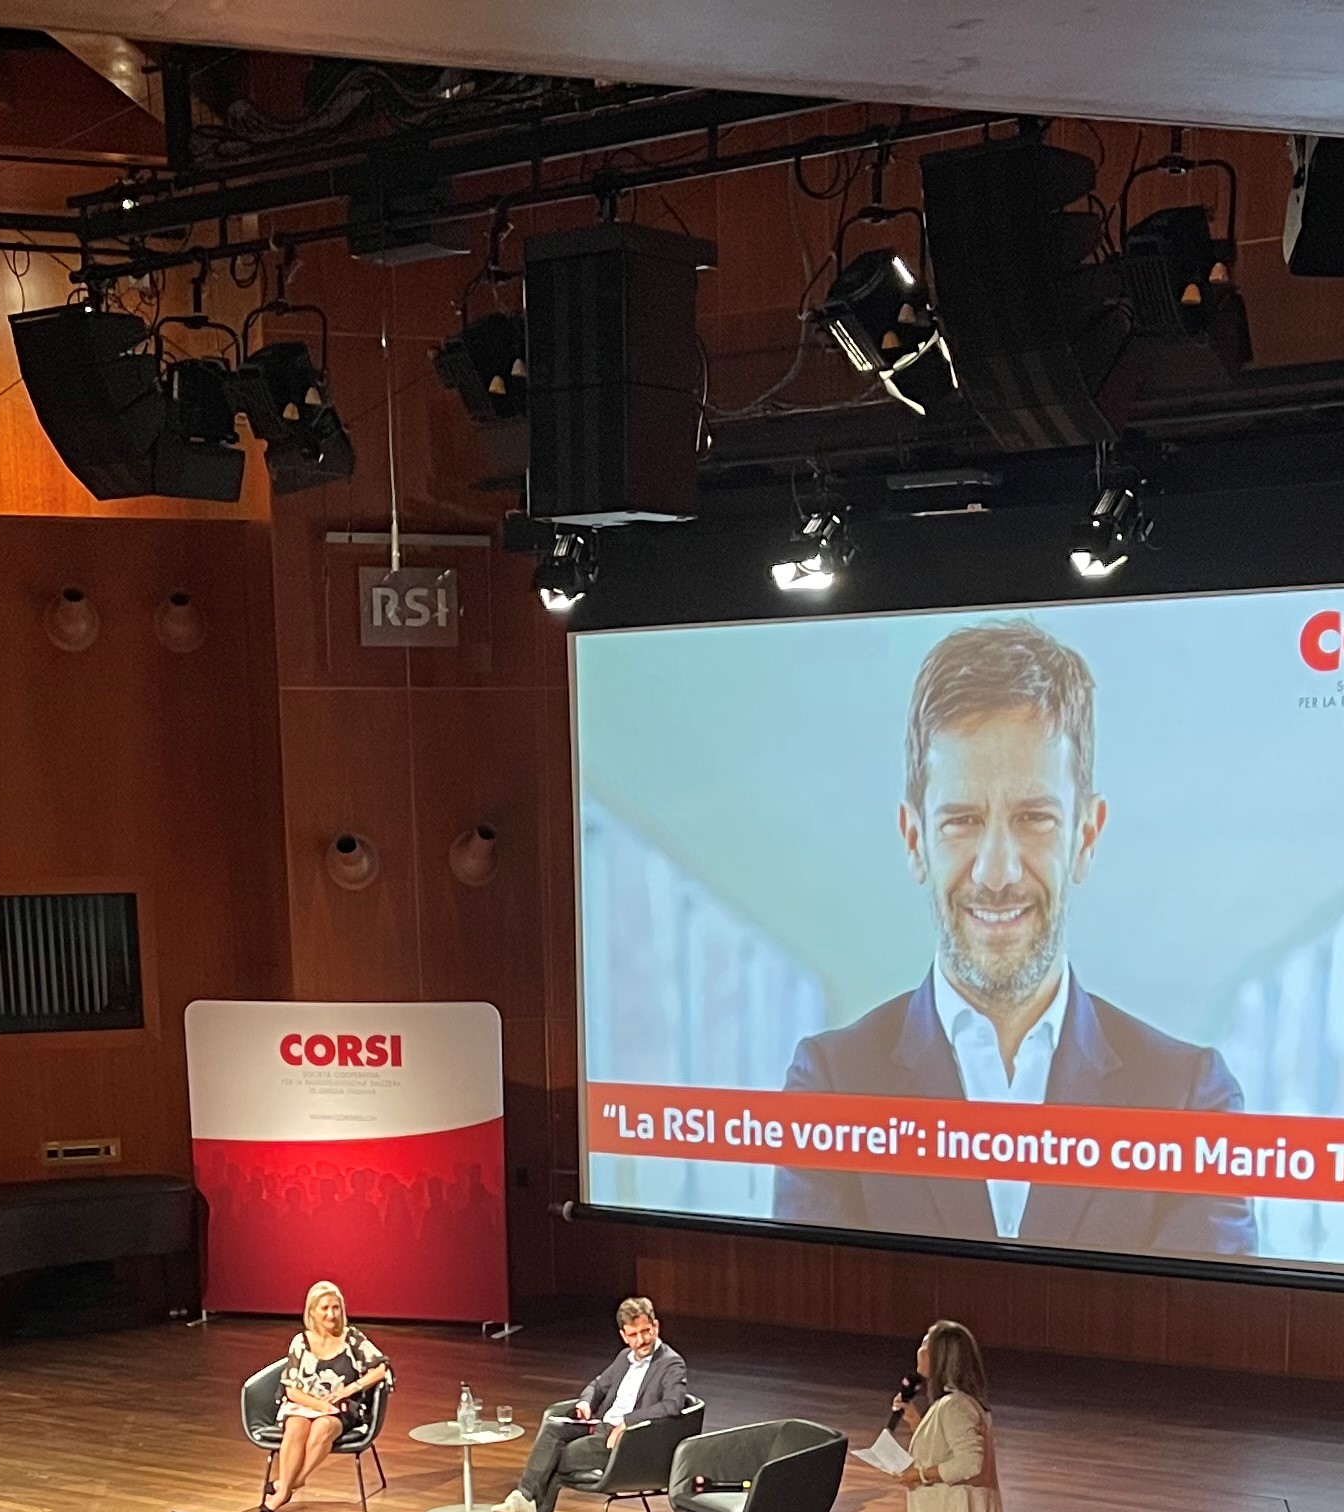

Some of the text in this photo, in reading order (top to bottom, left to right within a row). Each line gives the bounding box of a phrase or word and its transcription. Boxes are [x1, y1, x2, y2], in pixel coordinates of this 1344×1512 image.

[372, 586, 447, 627] RSI
[1299, 696, 1318, 709] PER
[1323, 696, 1336, 708] LA
[280, 1034, 402, 1067] CORSI
[663, 1107, 715, 1143] RSI
[724, 1110, 783, 1147] che
[791, 1117, 926, 1157] vorrei”:
[937, 1120, 1100, 1167] incontro
[1111, 1140, 1182, 1172] con
[1194, 1136, 1315, 1180] Mario
